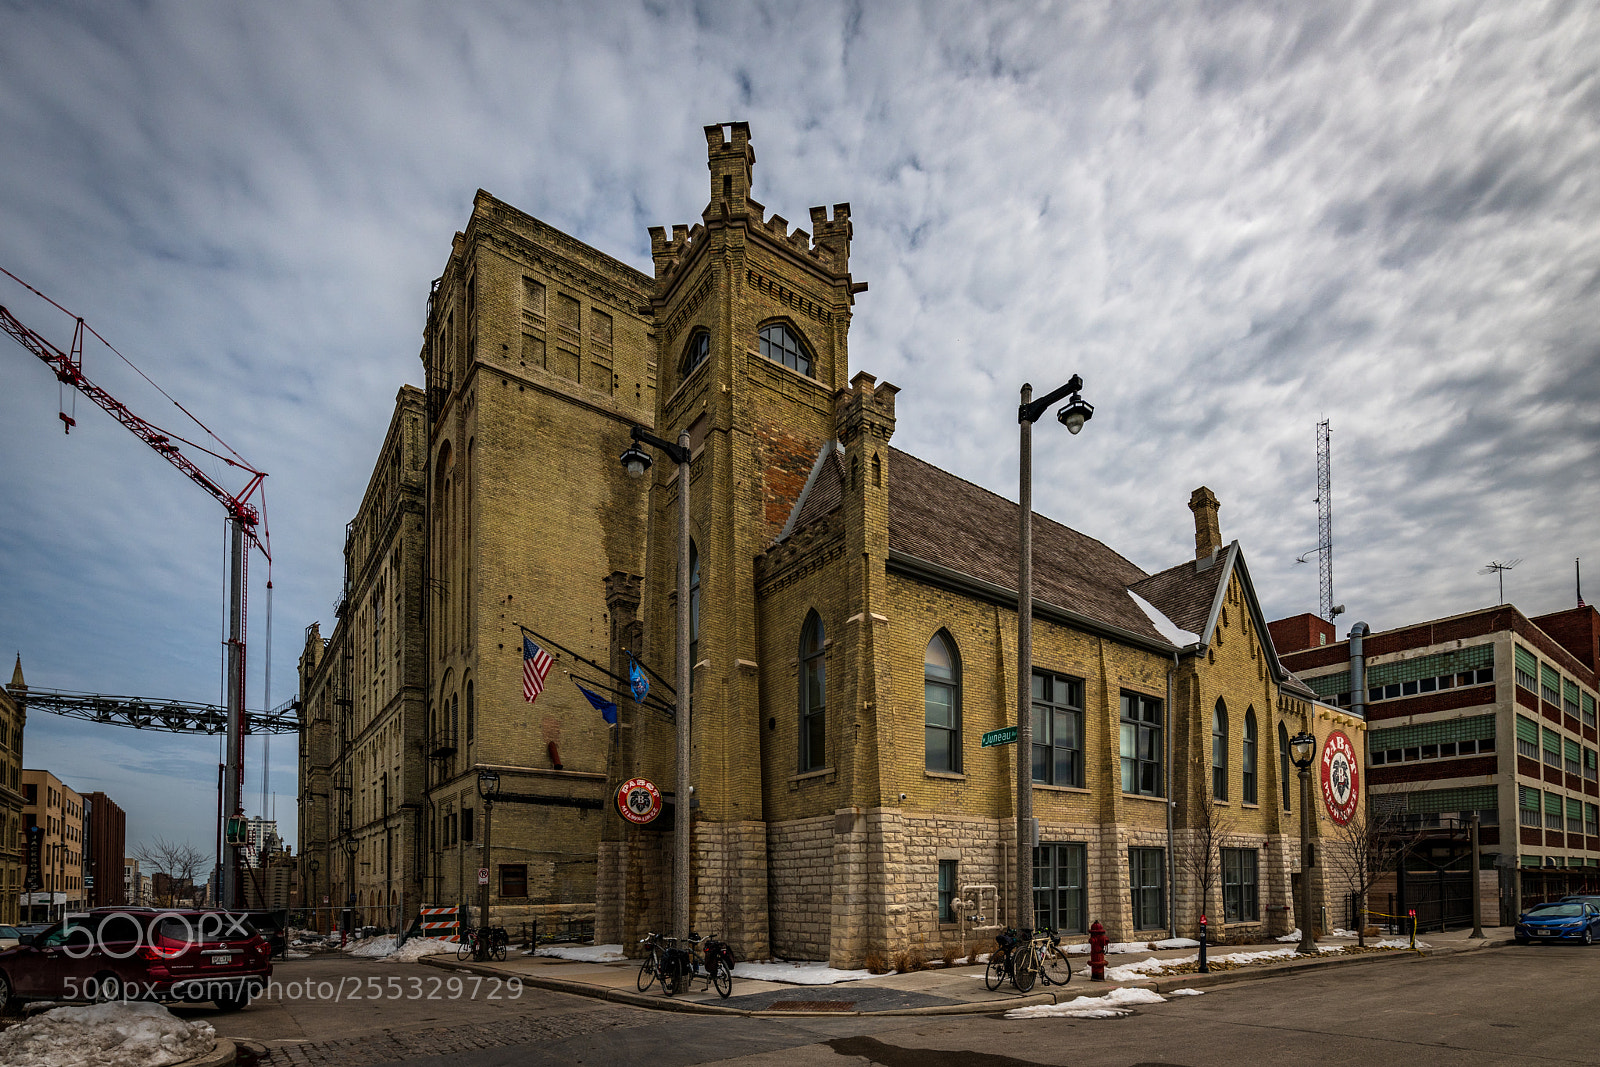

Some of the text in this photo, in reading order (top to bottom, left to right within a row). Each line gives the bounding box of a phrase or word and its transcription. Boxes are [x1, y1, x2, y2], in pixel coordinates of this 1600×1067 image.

[985, 732, 1010, 744] Juneau
[1323, 736, 1357, 774] PABST
[621, 779, 660, 797] PABST
[637, 795, 645, 804] B
